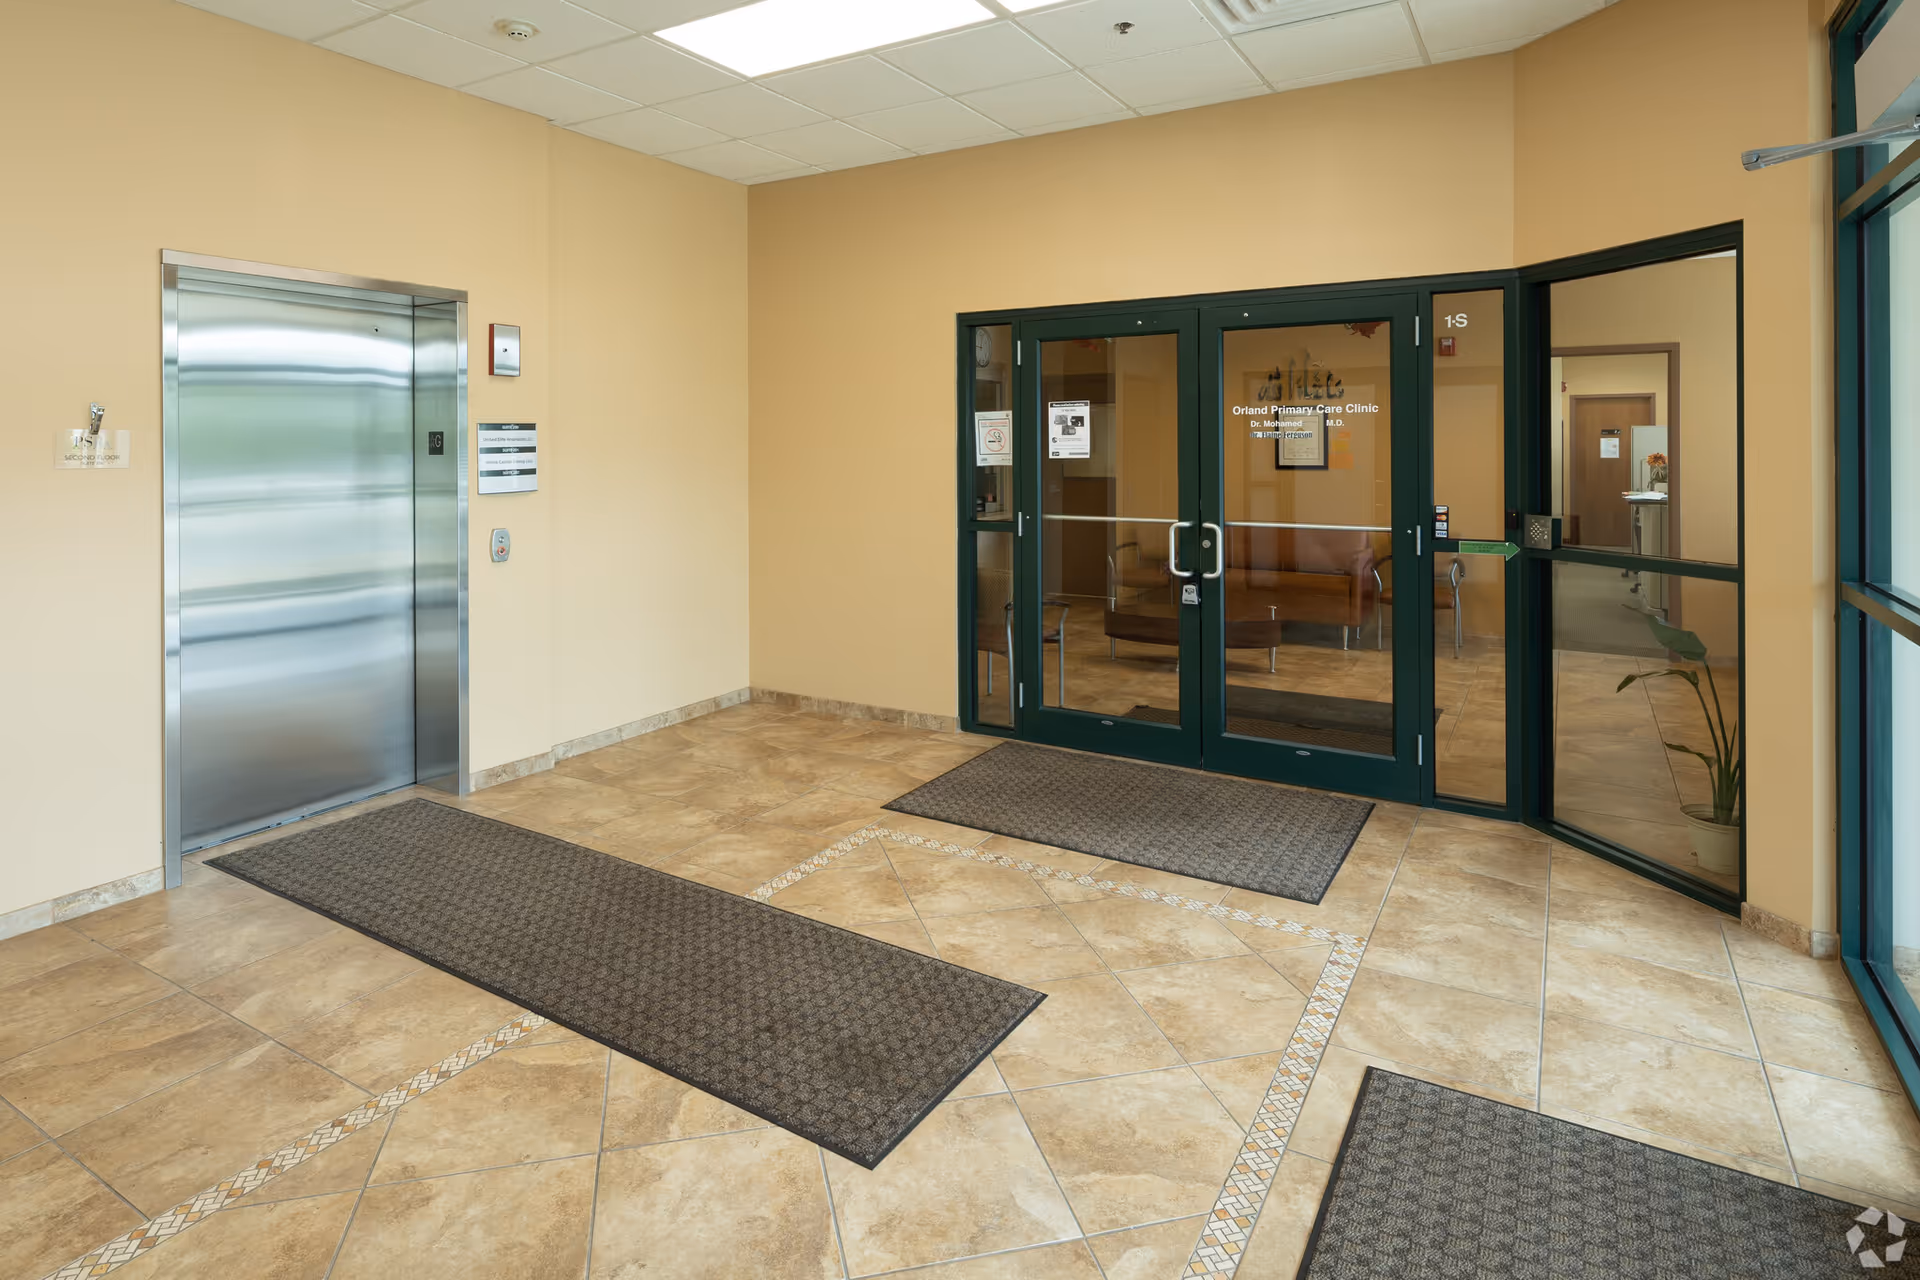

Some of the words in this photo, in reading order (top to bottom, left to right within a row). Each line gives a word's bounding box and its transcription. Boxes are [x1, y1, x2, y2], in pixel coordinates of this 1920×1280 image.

[1232, 405, 1268, 415] Orland
[1271, 404, 1313, 416] Primary
[1316, 404, 1343, 414] Care
[1345, 403, 1379, 413] Clinic
[1250, 420, 1262, 428] Dr.
[1263, 420, 1303, 428] Mohamed
[1326, 419, 1345, 427] M.D.
[1283, 431, 1313, 440] Ferguson
